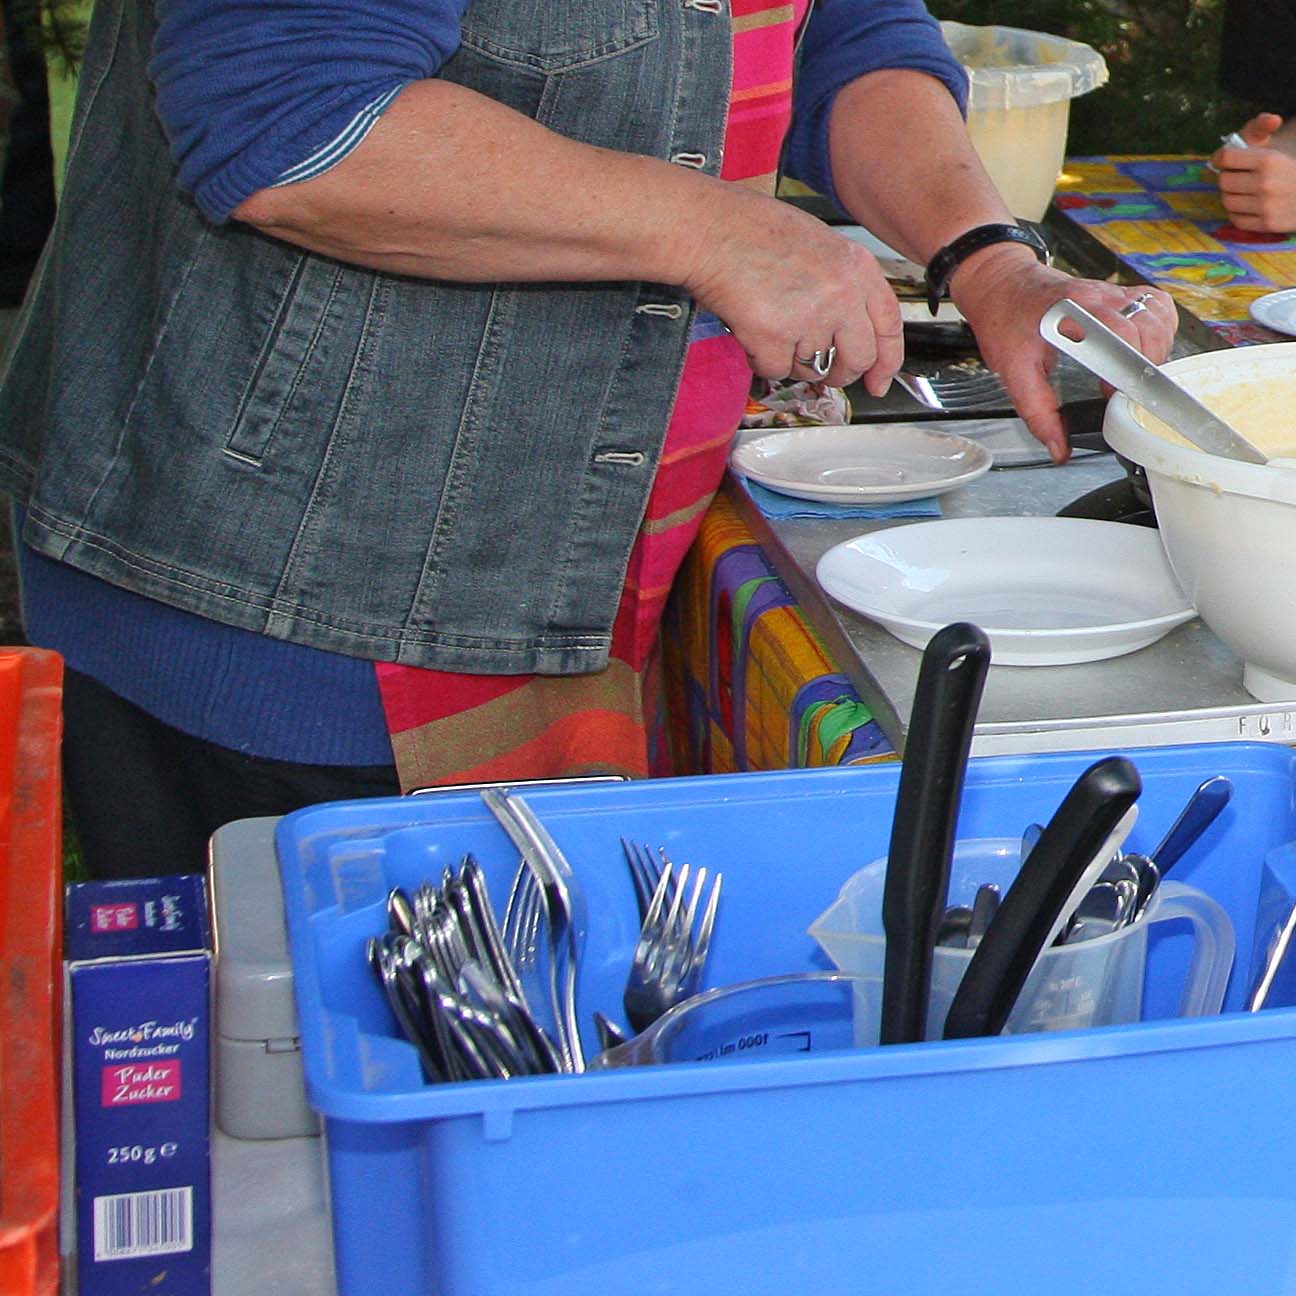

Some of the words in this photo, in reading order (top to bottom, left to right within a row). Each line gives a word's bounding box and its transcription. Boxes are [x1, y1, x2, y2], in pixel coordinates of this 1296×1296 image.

[105, 1043, 180, 1060] Nordzucker
[114, 1065, 172, 1084] Puder
[112, 1084, 174, 1102] Zucker
